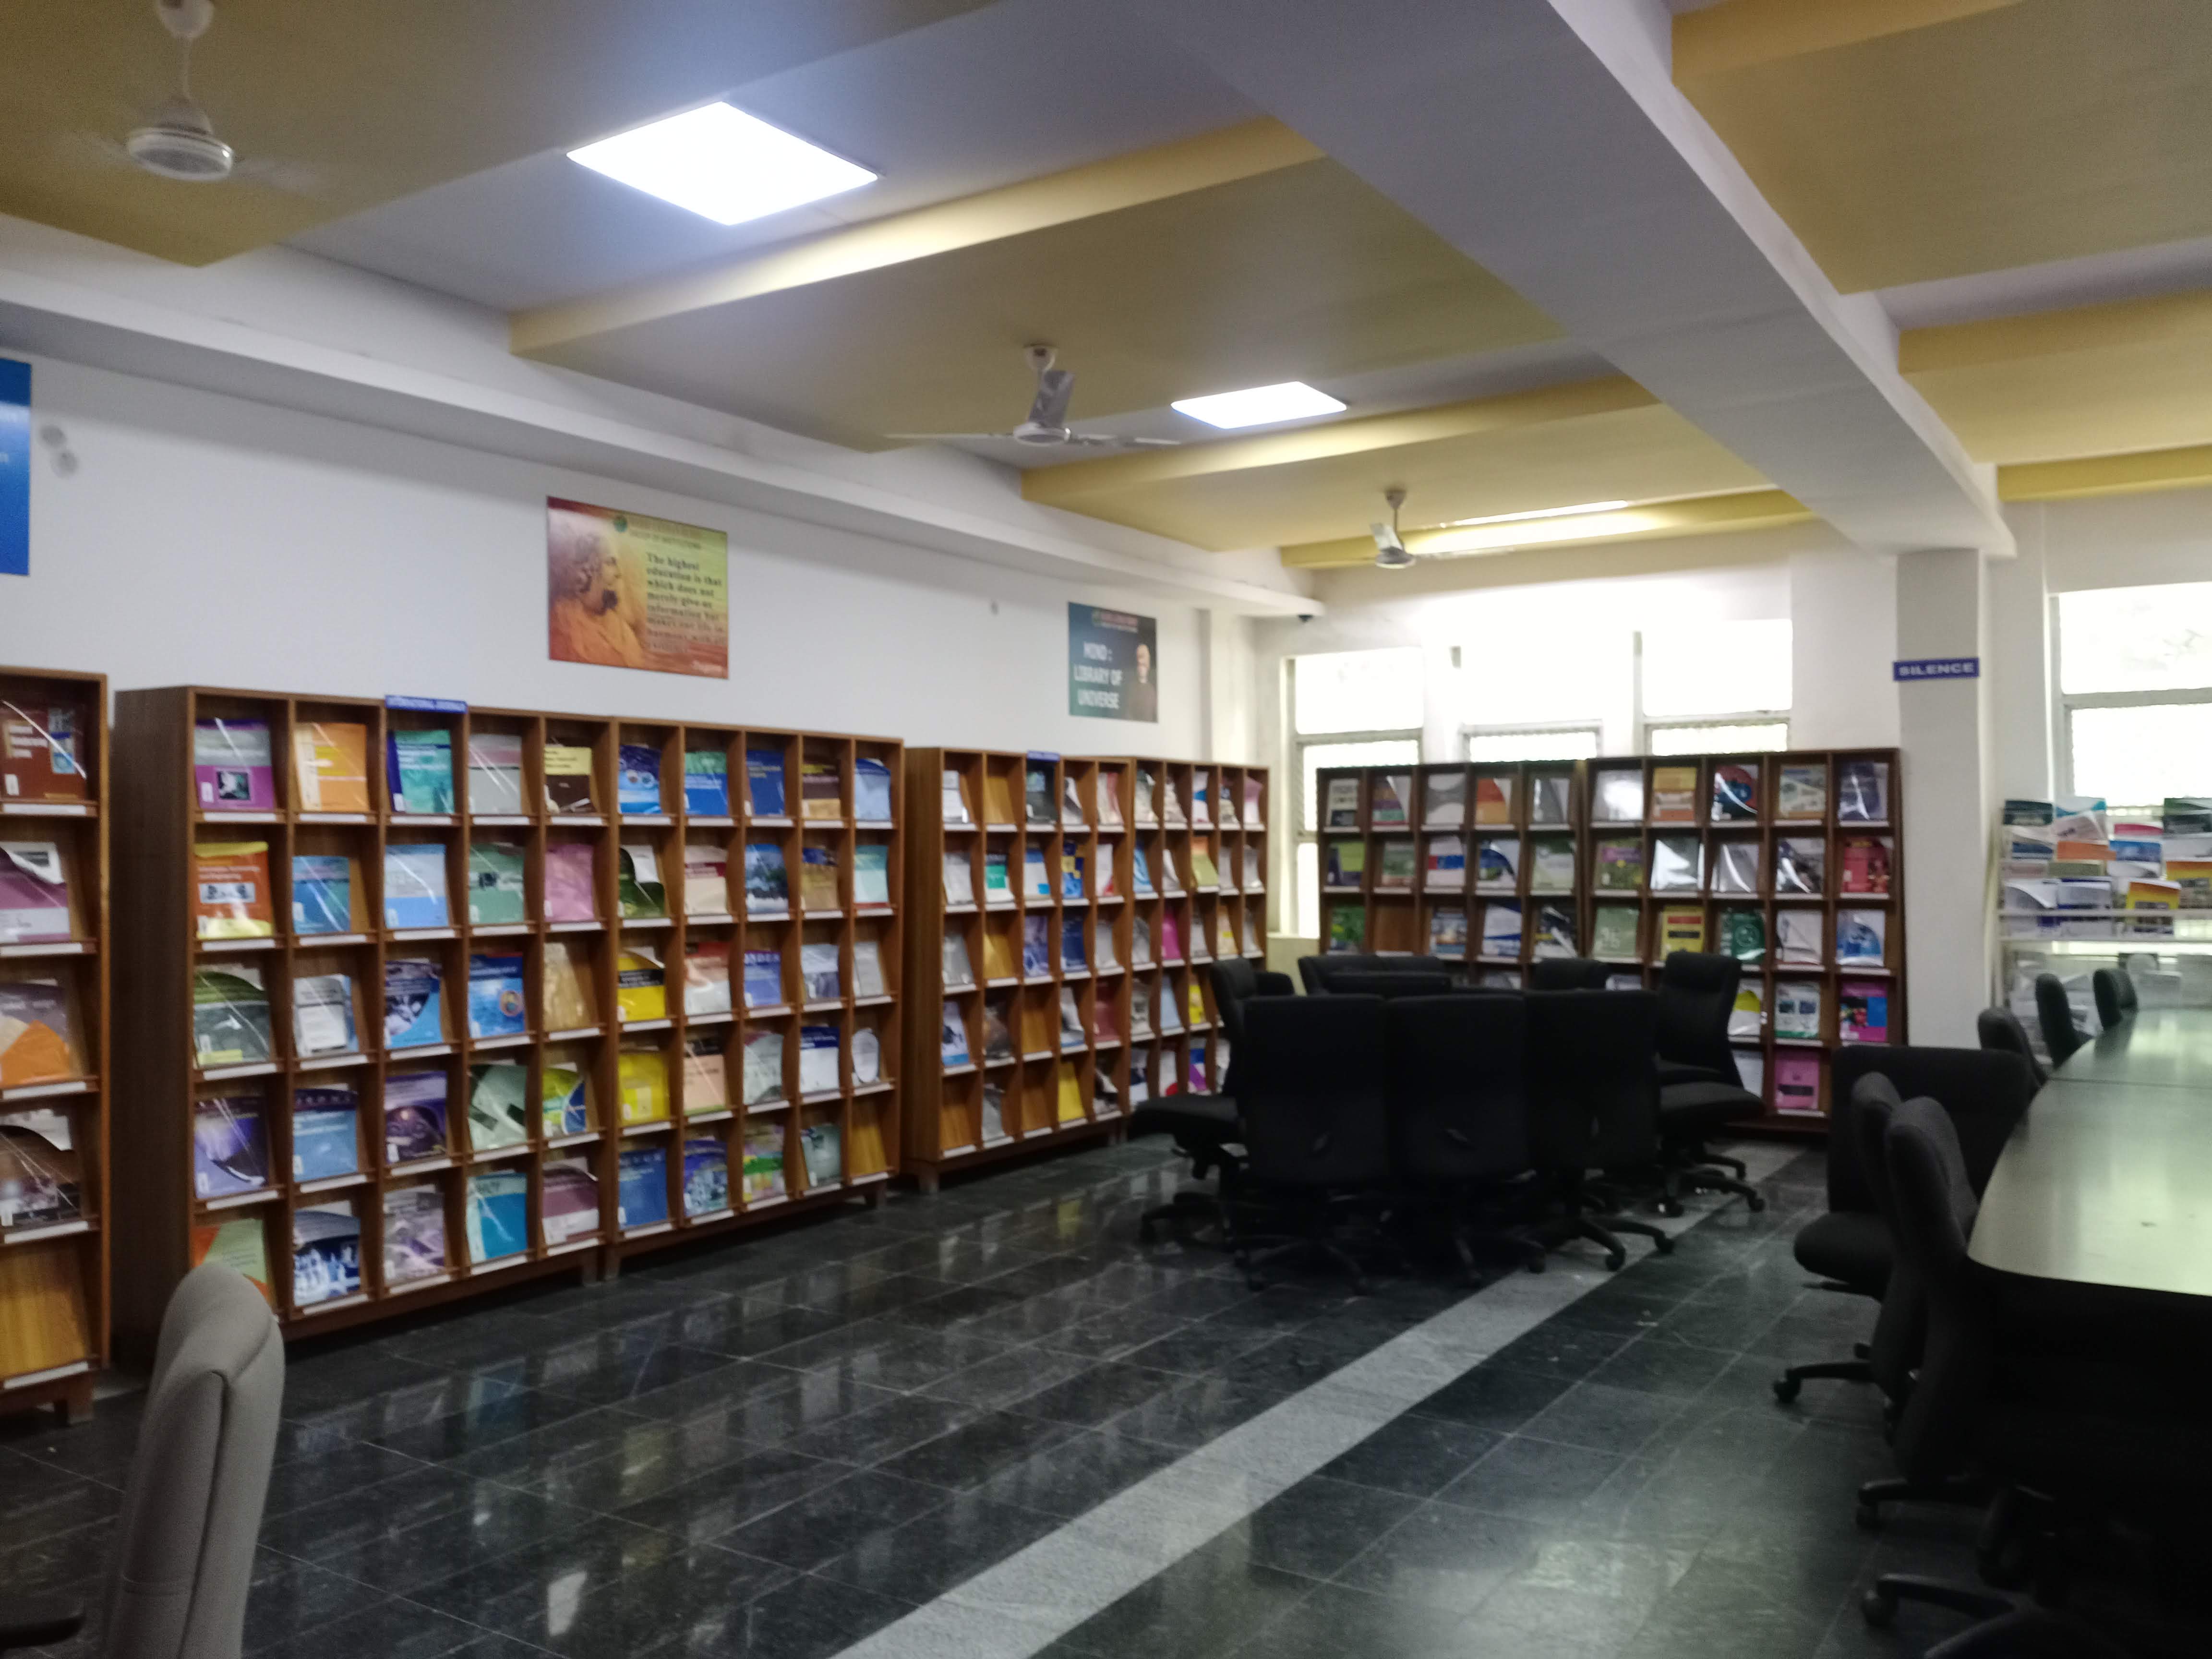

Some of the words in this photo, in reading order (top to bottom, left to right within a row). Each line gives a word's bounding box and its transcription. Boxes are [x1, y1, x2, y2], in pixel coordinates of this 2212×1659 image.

[647, 553, 664, 565] The
[668, 557, 699, 571] highest
[647, 567, 691, 582] education
[694, 574, 701, 584] is
[704, 576, 722, 587] that
[648, 579, 674, 591] which
[677, 583, 697, 595] does
[682, 596, 699, 608] give
[1899, 662, 1975, 676] SILENCE
